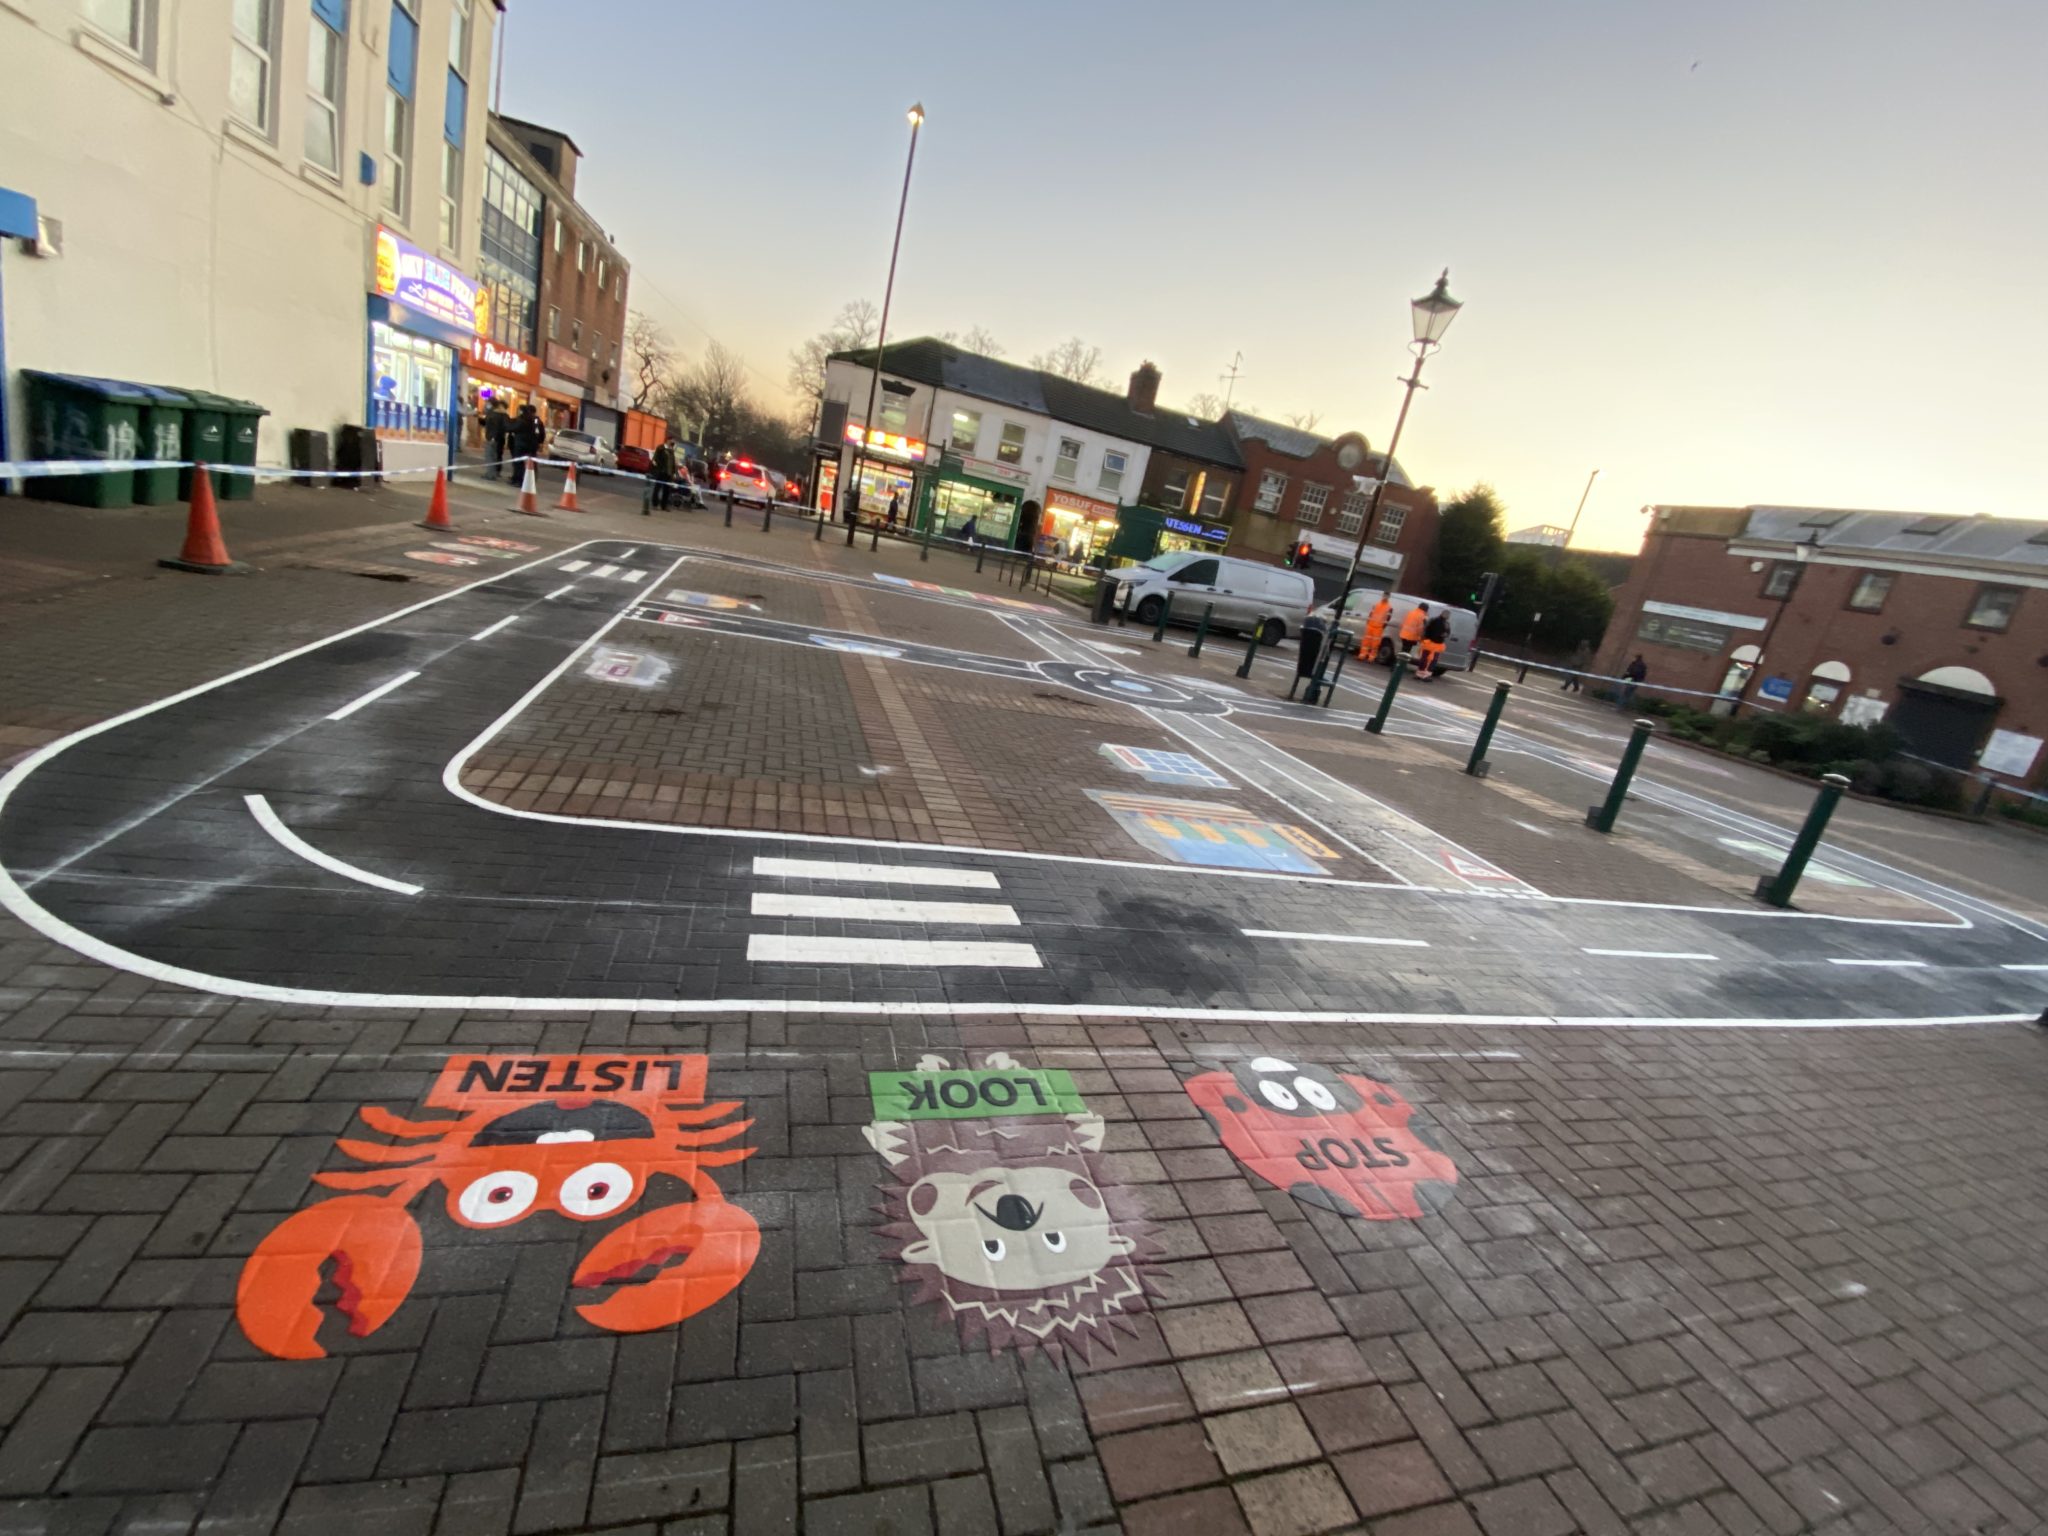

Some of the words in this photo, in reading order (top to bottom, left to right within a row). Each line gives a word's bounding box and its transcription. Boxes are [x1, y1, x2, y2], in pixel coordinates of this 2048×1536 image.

[1053, 493, 1093, 511] YOSUF
[456, 1060, 683, 1093] LISTEN
[898, 1077, 1048, 1111] LOOK
[1295, 1137, 1410, 1171] STOP
